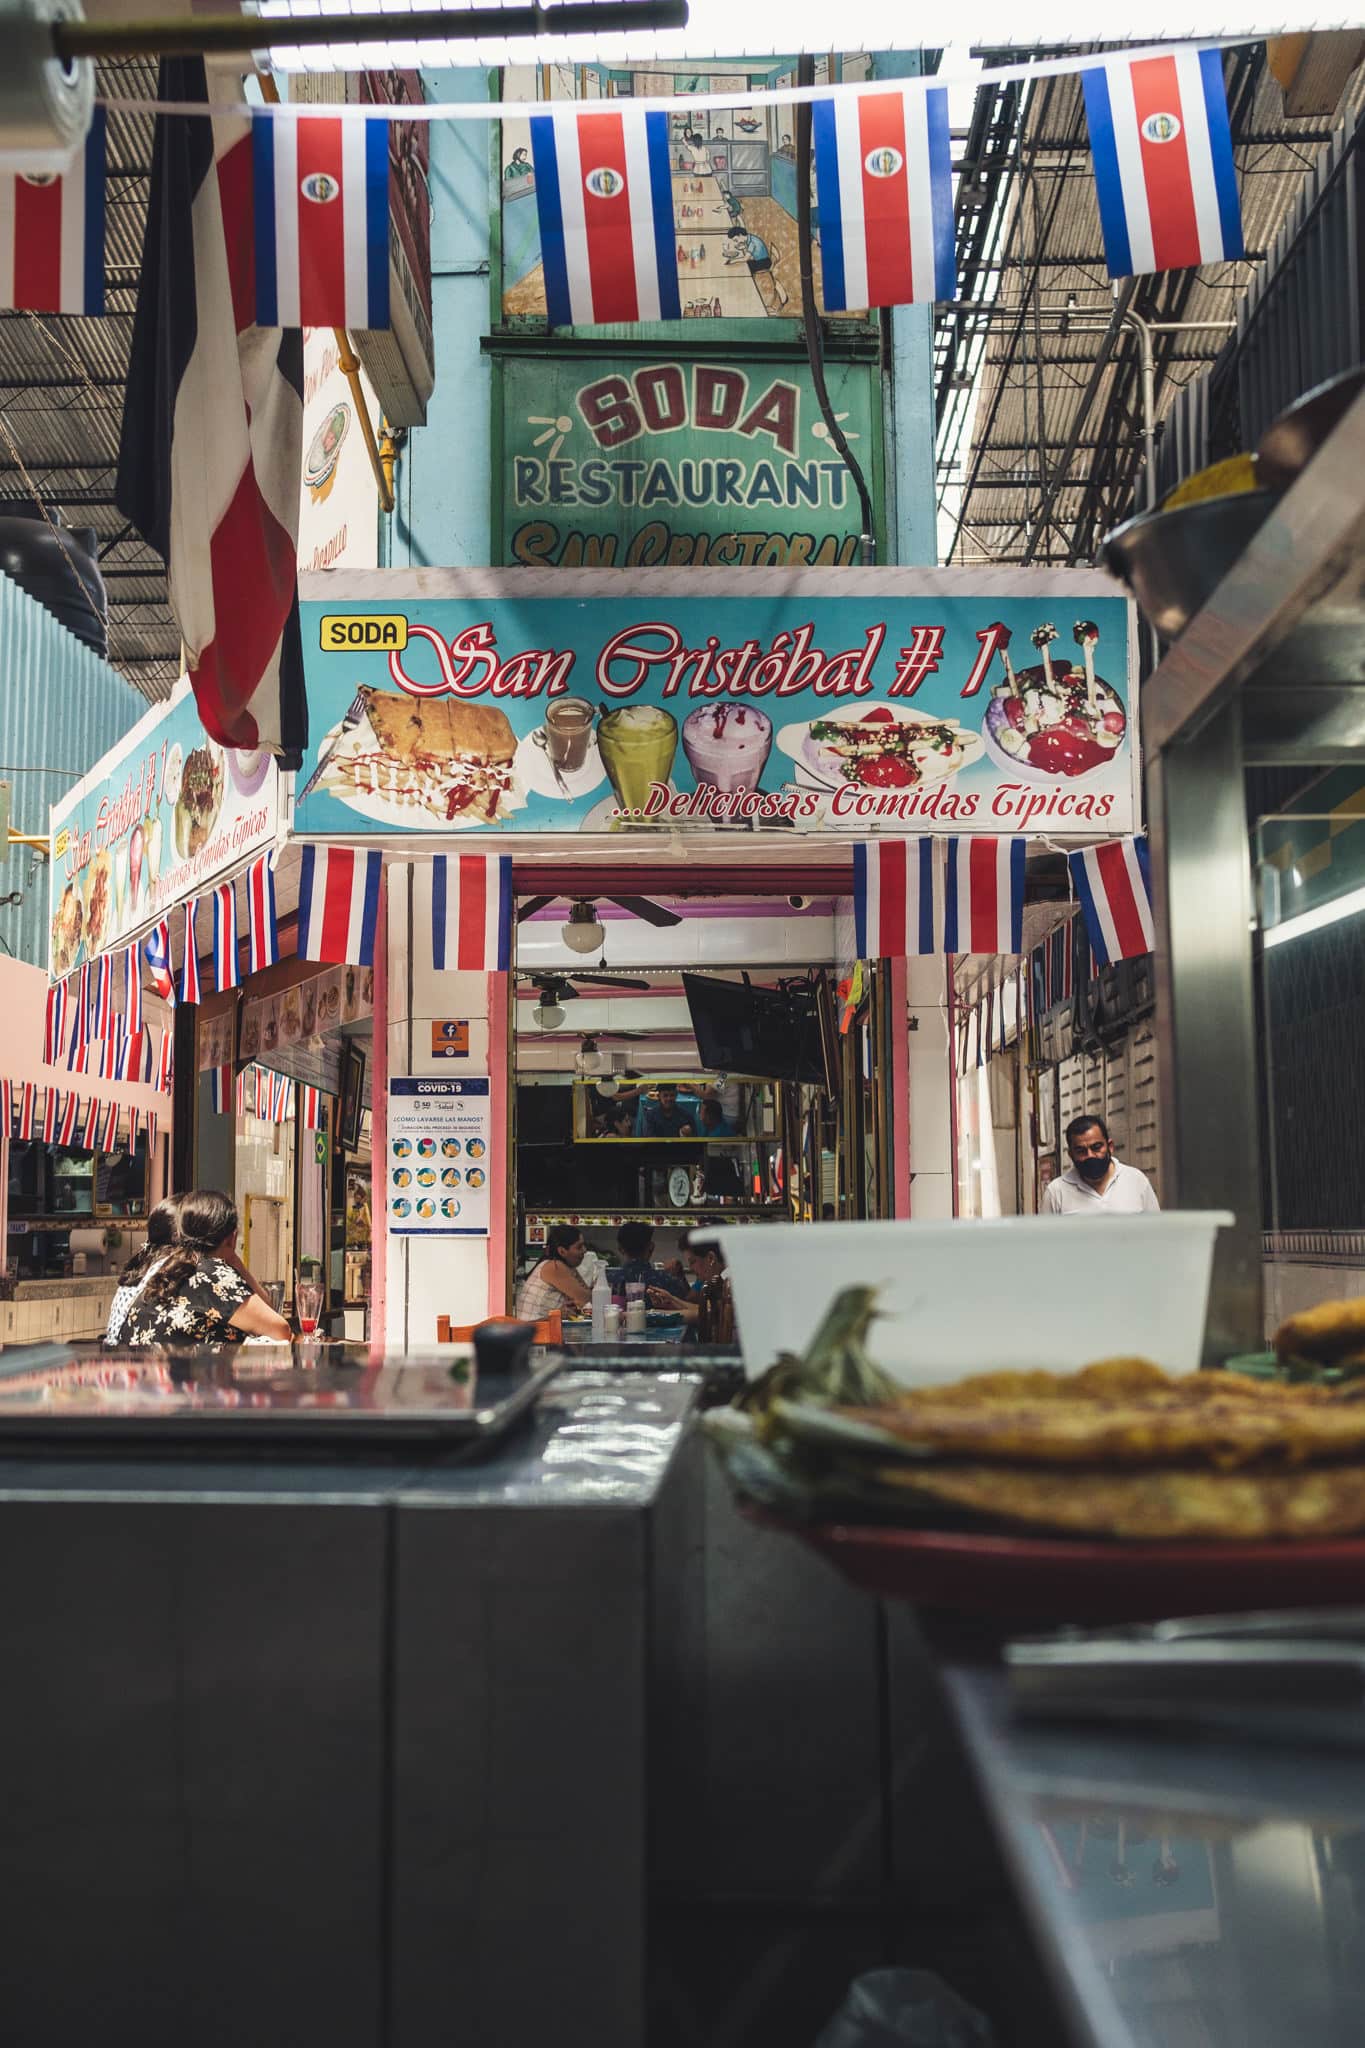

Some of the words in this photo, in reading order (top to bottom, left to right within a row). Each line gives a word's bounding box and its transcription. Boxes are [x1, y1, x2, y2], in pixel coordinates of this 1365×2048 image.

[577, 363, 800, 460] SODA
[514, 457, 851, 510] RESTAURANT
[330, 622, 398, 644] SODA
[388, 622, 576, 698] San
[596, 621, 886, 698] Cristóbal
[888, 625, 945, 697] #
[960, 626, 1002, 697] 1
[831, 782, 980, 820] Comidas
[991, 782, 1115, 830] Típicas
[418, 1084, 461, 1093] COVID-19
